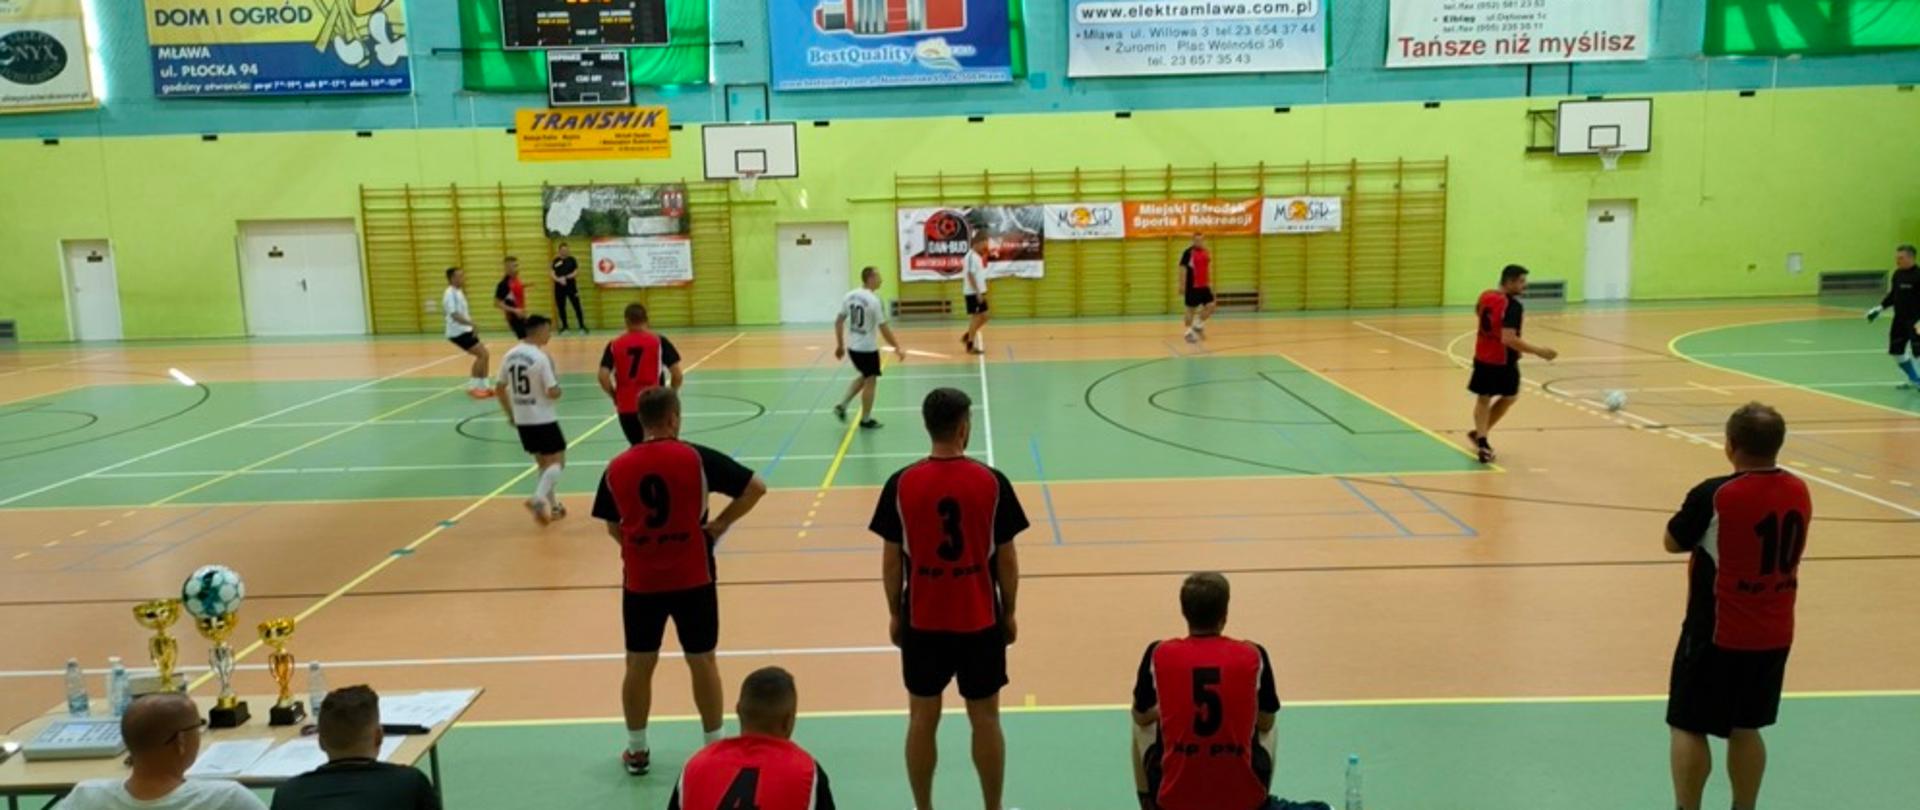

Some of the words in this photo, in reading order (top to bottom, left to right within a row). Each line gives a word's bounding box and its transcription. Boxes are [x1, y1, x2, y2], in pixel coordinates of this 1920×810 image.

[155, 9, 209, 26] DOM
[216, 9, 222, 25] I
[230, 2, 313, 25] OGRÓD
[1081, 1, 1312, 19] www.elektramlawa.com.pl
[1201, 26, 1210, 37] 3
[1235, 25, 1251, 36] 23
[1254, 23, 1277, 35] 654
[1281, 23, 1298, 34] 37
[158, 46, 211, 60] MŁAWA
[1177, 40, 1205, 52] Plac
[1267, 38, 1285, 49] 36
[1398, 35, 1486, 58] Tańsze
[1495, 33, 1531, 55] niż
[1539, 31, 1636, 58] myślisz
[809, 46, 914, 65] BestQuality
[1170, 56, 1186, 66] 23
[1189, 55, 1213, 66] 657
[1217, 54, 1233, 65] 35
[1235, 54, 1251, 64] 43
[160, 65, 177, 78] ul.
[181, 64, 237, 77] PŁOCKA
[240, 63, 259, 76] 94
[162, 82, 201, 94] godziny
[530, 110, 664, 131] TRANSMIK
[1139, 203, 1187, 217] Miejski
[1133, 216, 1177, 229] Sportu
[1188, 213, 1253, 227] Rekreacji
[849, 303, 865, 330] 10
[627, 347, 645, 379] 7
[508, 364, 530, 396] 15
[639, 473, 671, 528] 9
[936, 496, 965, 561] 3
[1754, 509, 1806, 576] 10
[1192, 666, 1223, 737] 5
[716, 766, 761, 810] 4
